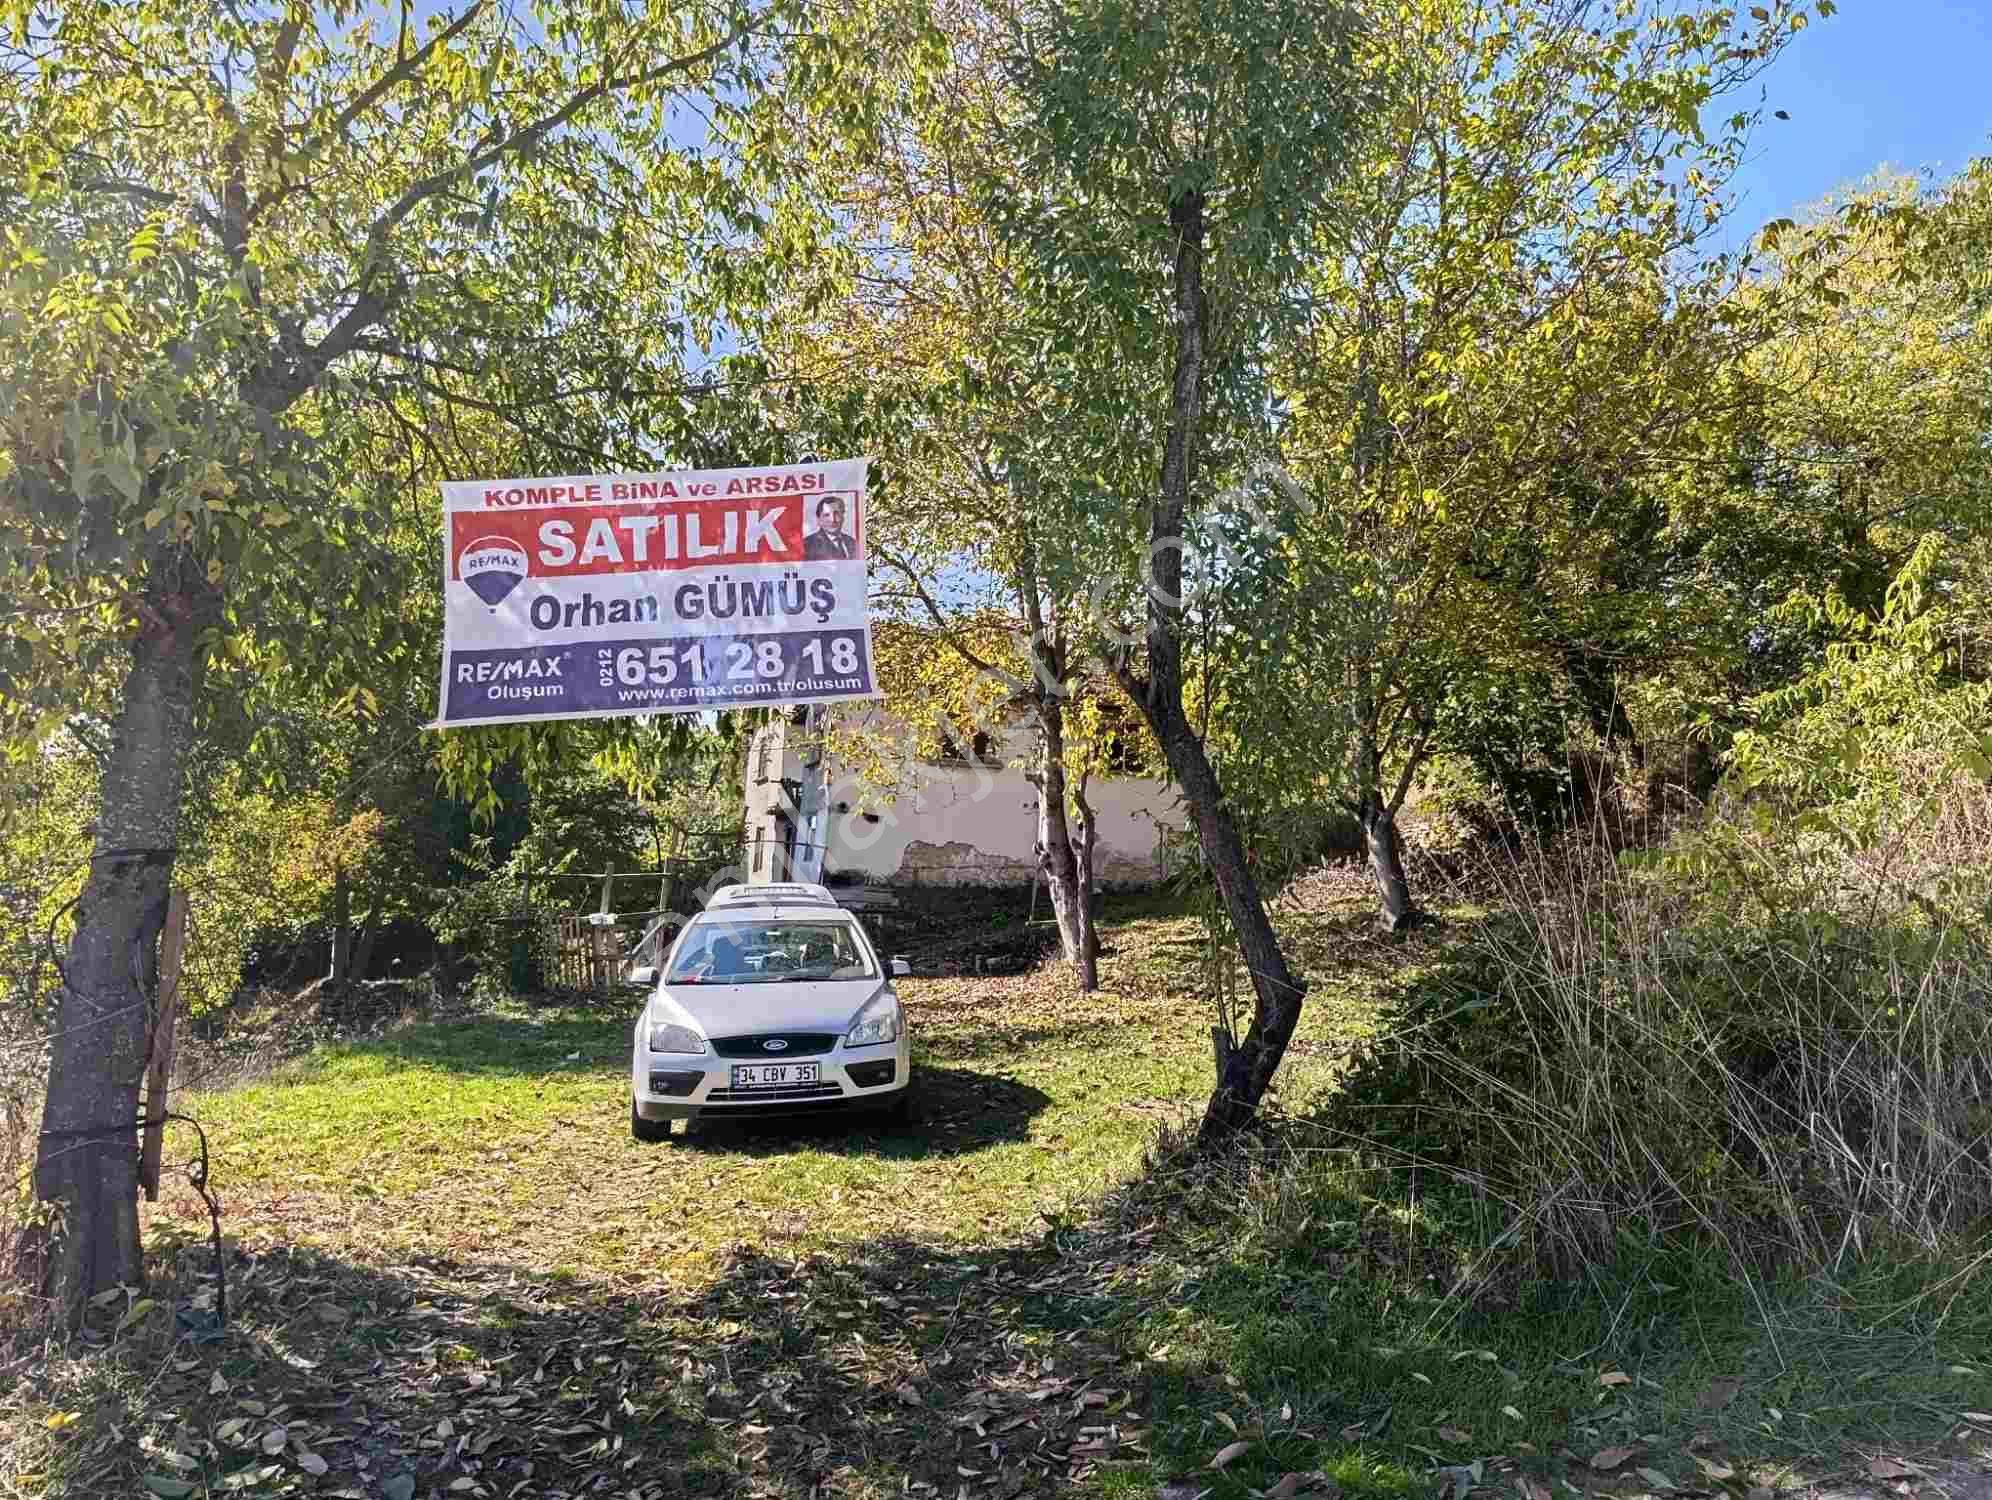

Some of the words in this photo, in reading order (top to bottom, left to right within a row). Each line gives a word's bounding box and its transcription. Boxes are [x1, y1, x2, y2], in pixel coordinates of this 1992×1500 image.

[484, 484, 602, 507] KOMPLE
[611, 480, 679, 500] BiNA
[687, 482, 718, 497] ve
[726, 472, 825, 496] ARSASI
[538, 506, 788, 567] SATILIK
[469, 556, 520, 569] RE/MAX
[529, 592, 658, 631] Orhan
[673, 572, 837, 624] GÜMÜŞ
[457, 655, 564, 684] RE/MAX
[598, 647, 614, 687] 0212
[616, 644, 705, 687] 651
[724, 641, 785, 680] 28
[801, 637, 859, 676] 18
[487, 682, 565, 701] Oluşum
[618, 677, 862, 702] www.remax.com.tr/olusum
[740, 1068, 756, 1083] 34
[795, 1065, 817, 1081] 351
